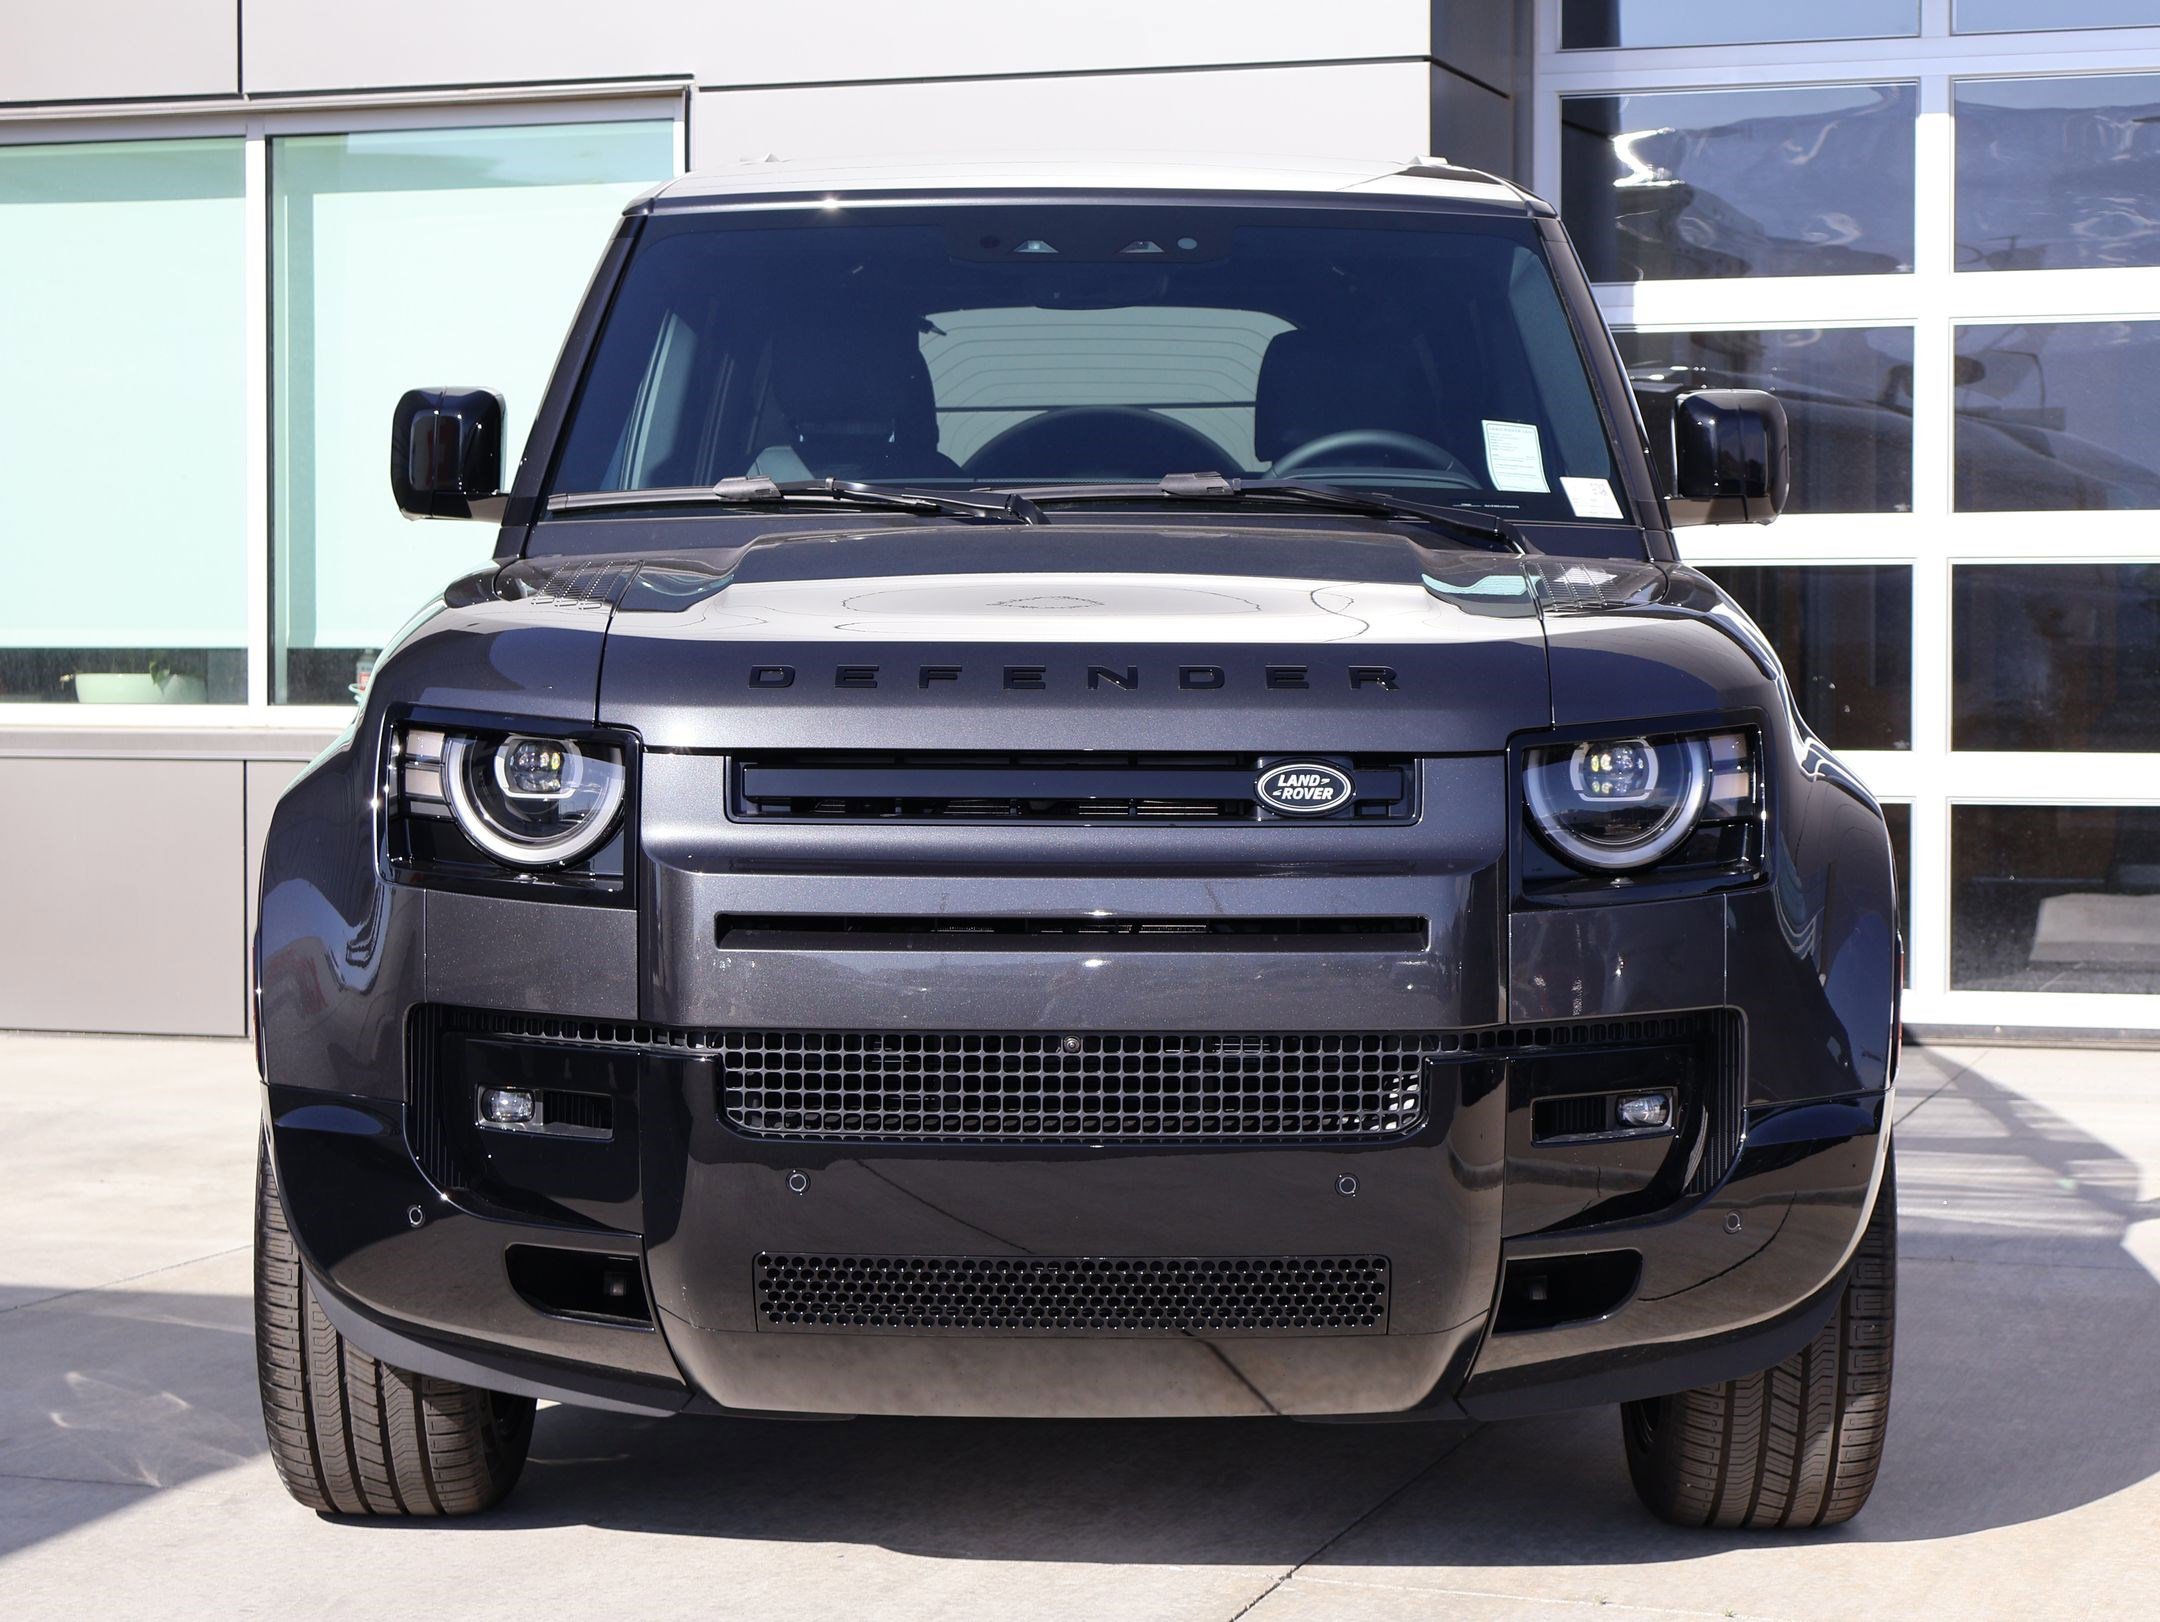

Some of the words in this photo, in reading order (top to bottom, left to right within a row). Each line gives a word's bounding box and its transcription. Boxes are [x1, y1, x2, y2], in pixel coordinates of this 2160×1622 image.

[748, 664, 1401, 690] DEFENDER
[1277, 774, 1321, 787] LAND
[1281, 787, 1334, 800] ROVER
